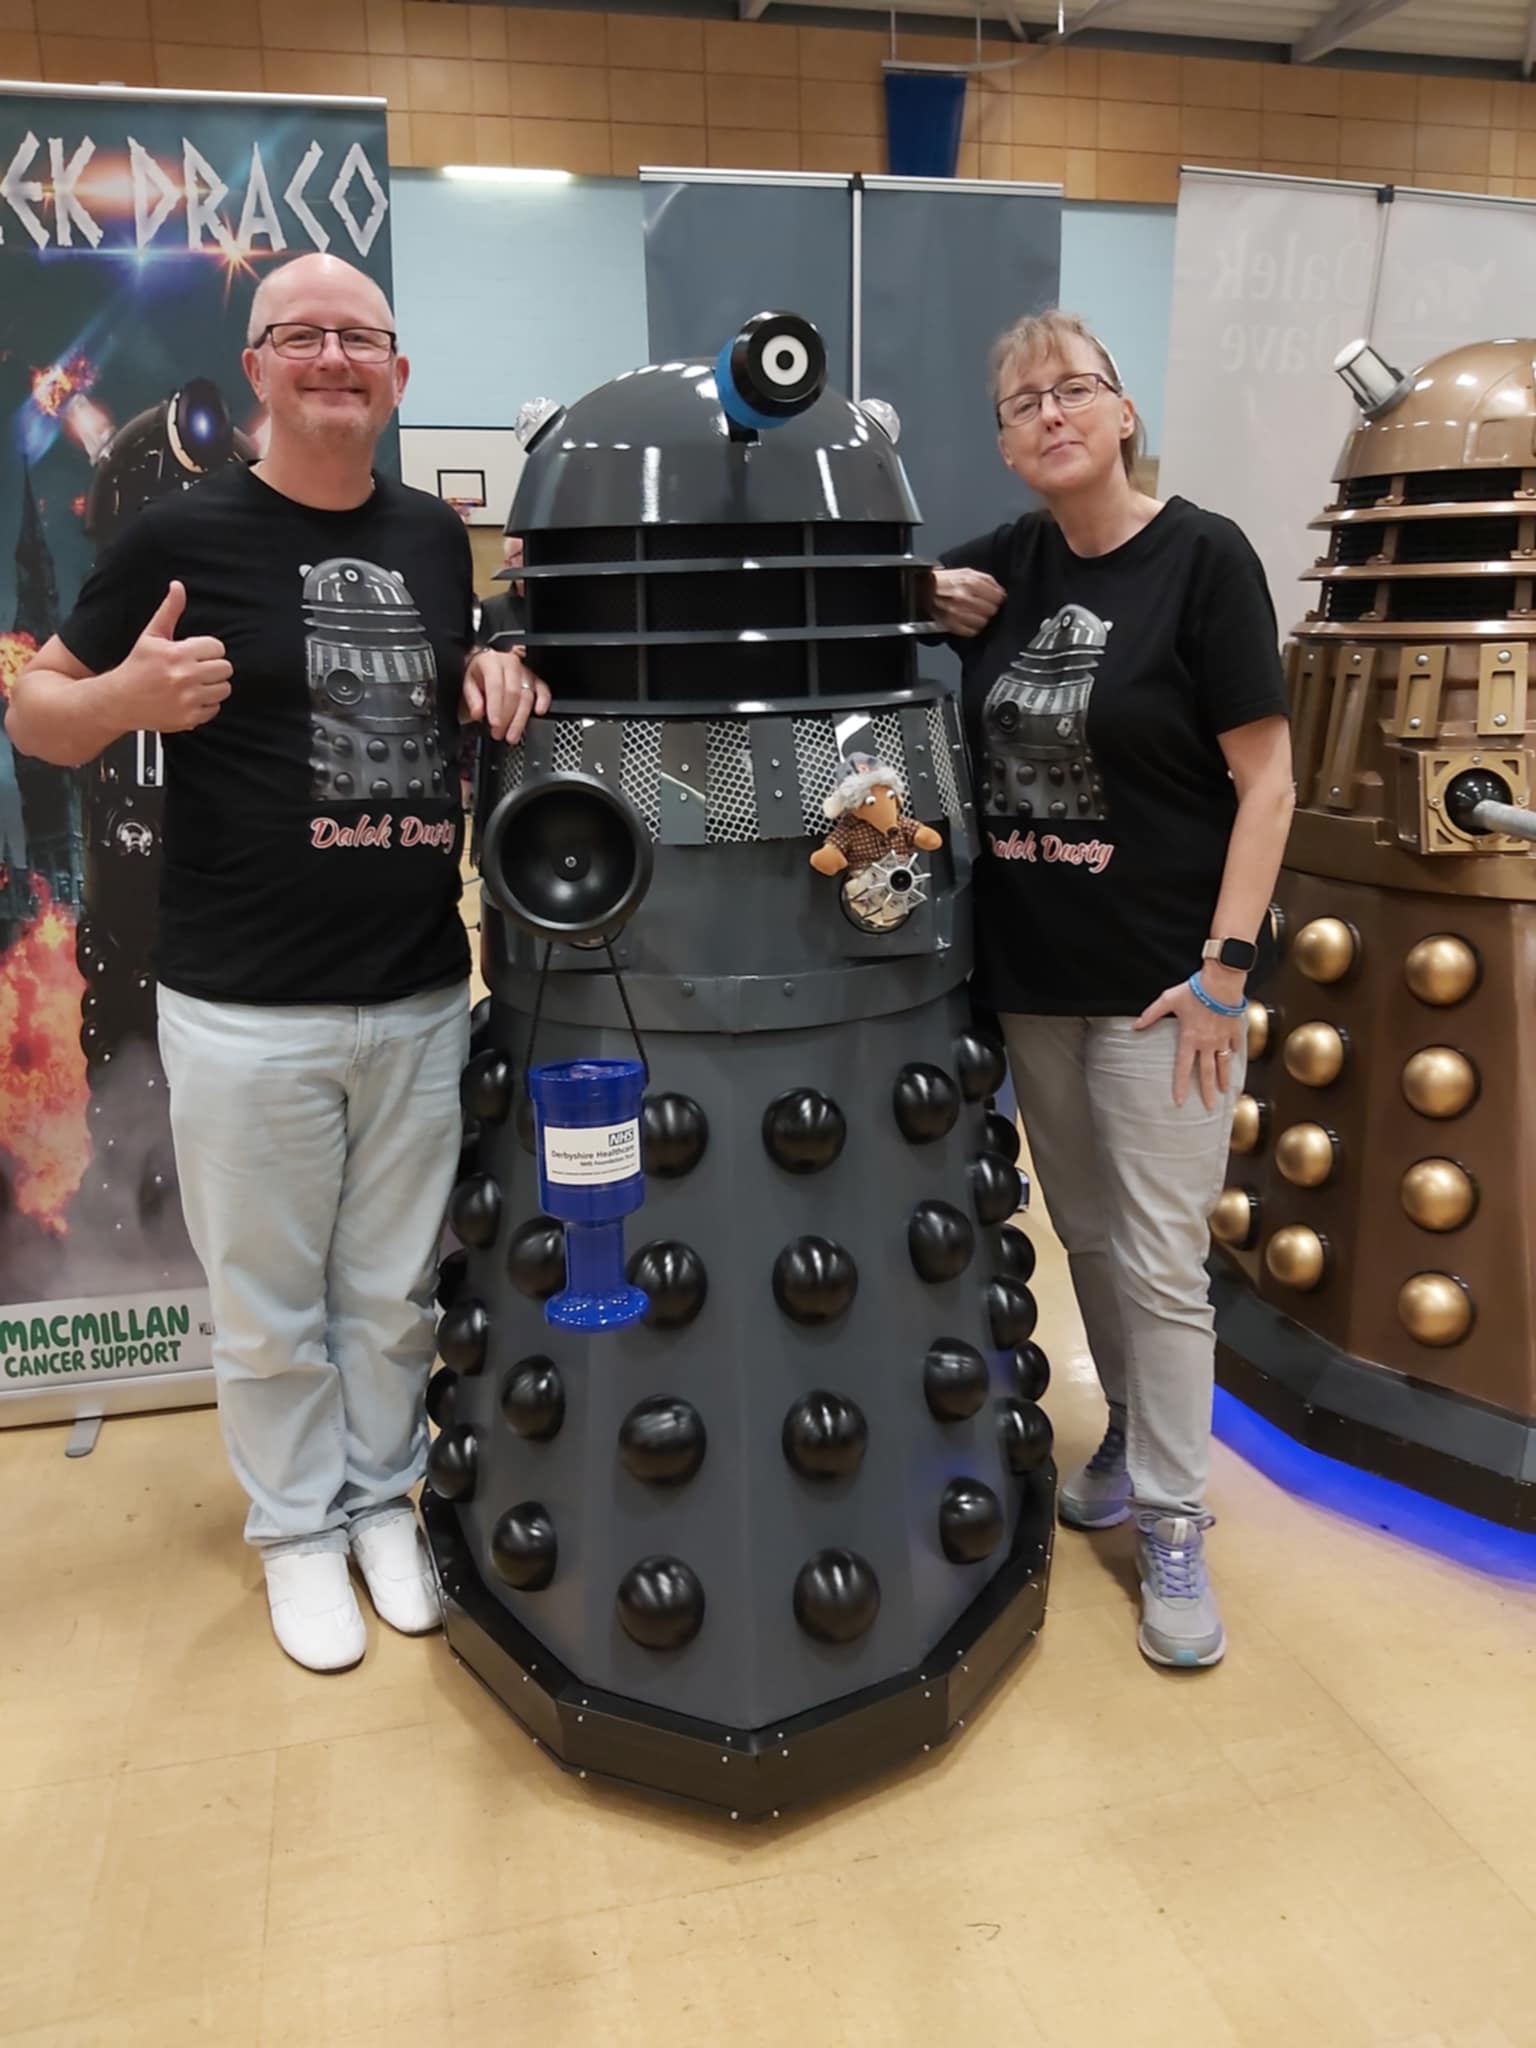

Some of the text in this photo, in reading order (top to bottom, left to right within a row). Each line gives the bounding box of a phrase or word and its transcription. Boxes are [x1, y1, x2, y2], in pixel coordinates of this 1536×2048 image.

[0, 131, 388, 257] EK DRACO
[310, 814, 456, 854] Dalek Dusty
[1041, 834, 1115, 874] Dusty
[551, 1145, 635, 1161] Derbyshire Healthcare
[609, 1129, 634, 1146] NHS
[0, 1304, 189, 1354] MACMILLAN
[4, 1340, 182, 1378] CANCER SUPPORT
